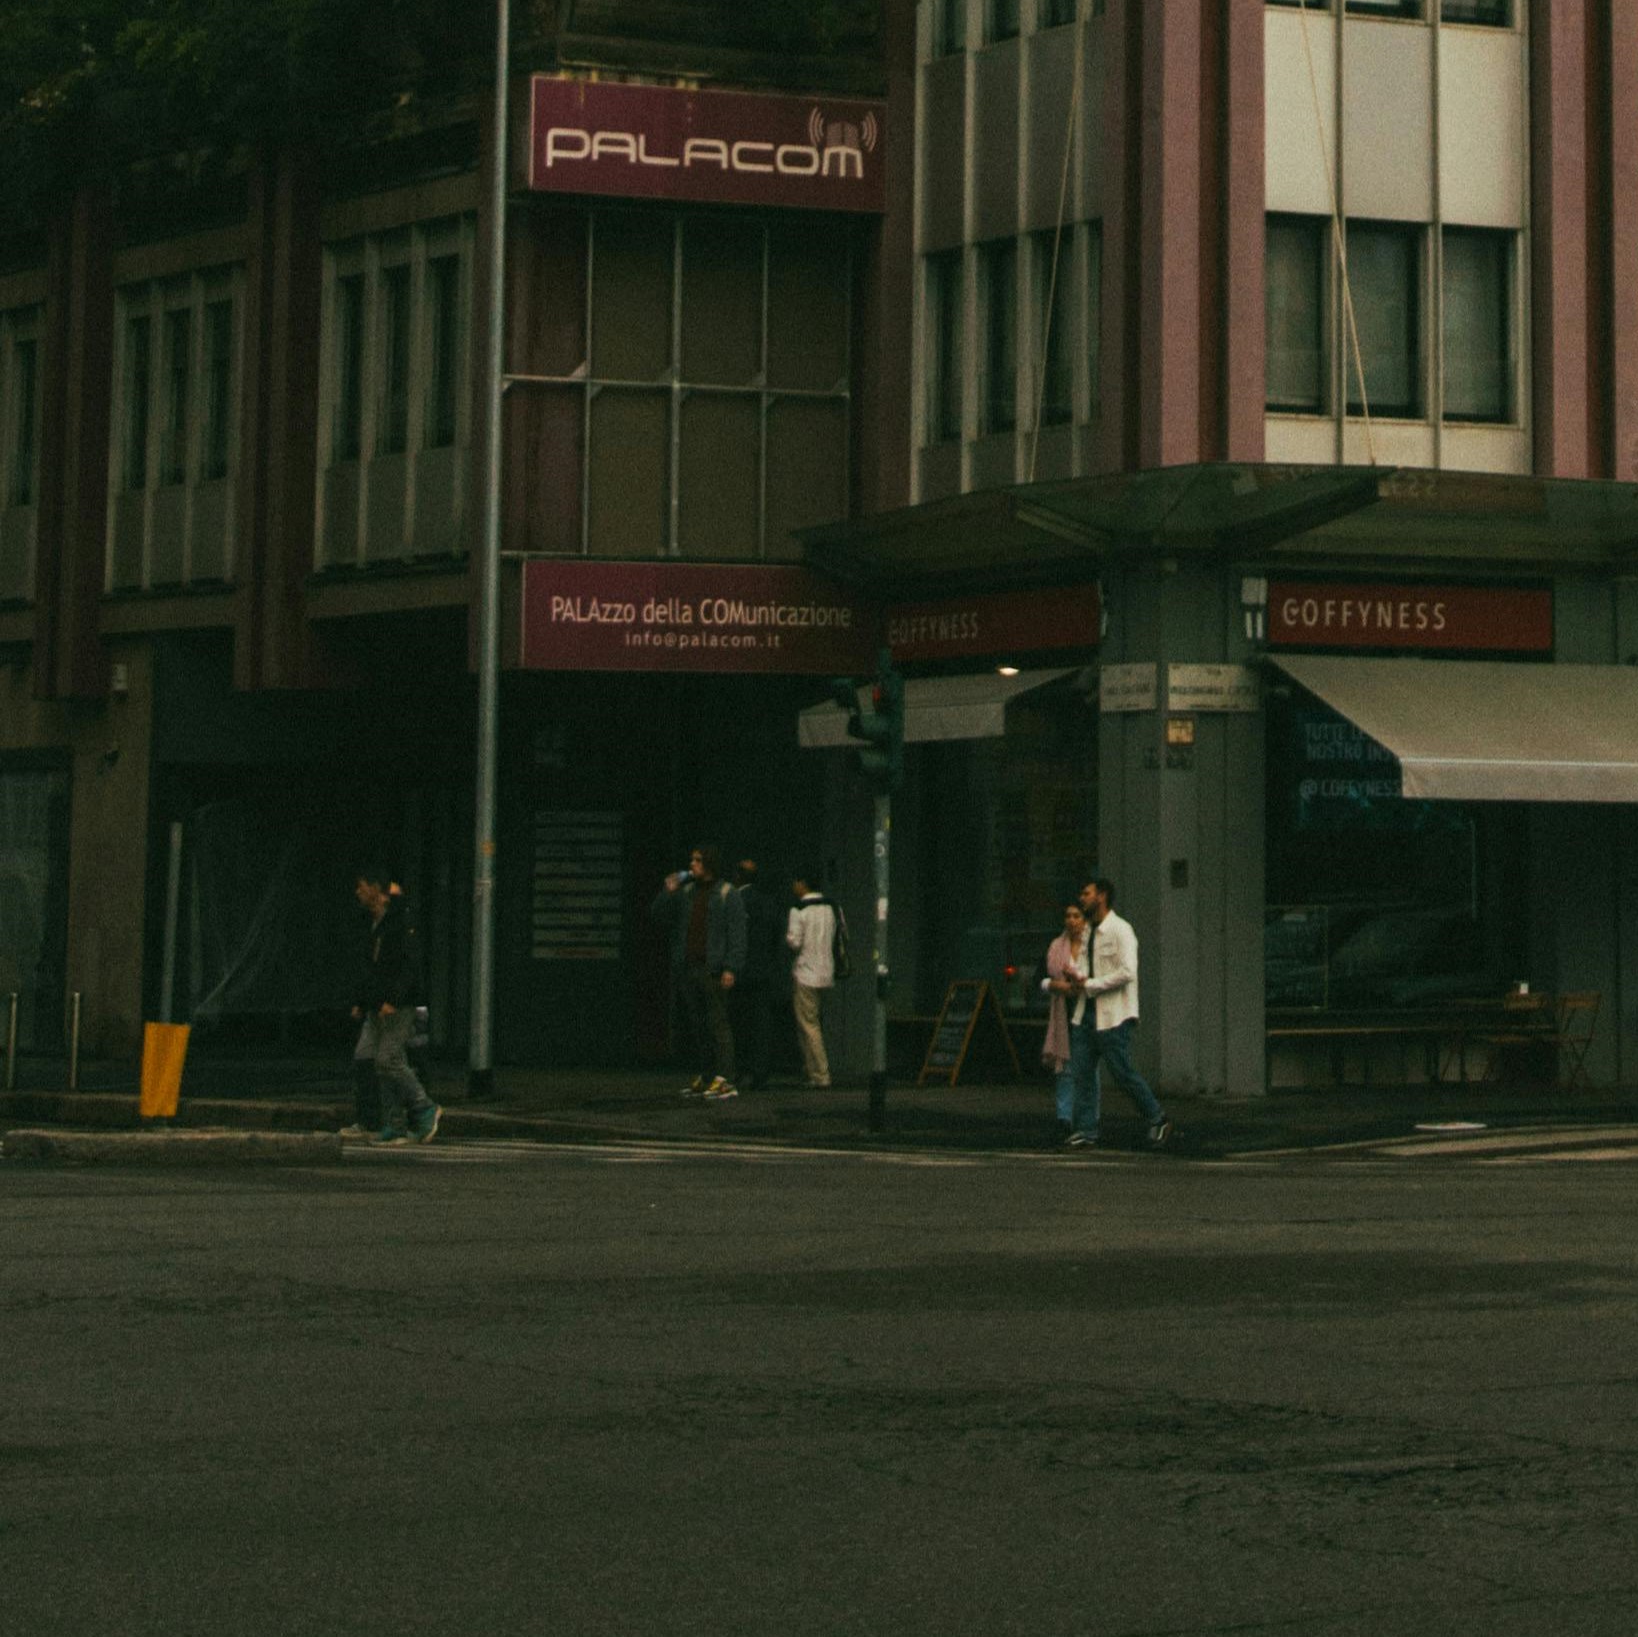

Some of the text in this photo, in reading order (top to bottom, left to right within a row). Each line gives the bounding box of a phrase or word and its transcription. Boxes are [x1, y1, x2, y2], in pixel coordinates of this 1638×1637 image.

[546, 127, 863, 179] PALACOM
[551, 595, 852, 628] PALAzzo della COMunicazione
[624, 631, 782, 650] info@palacom.it
